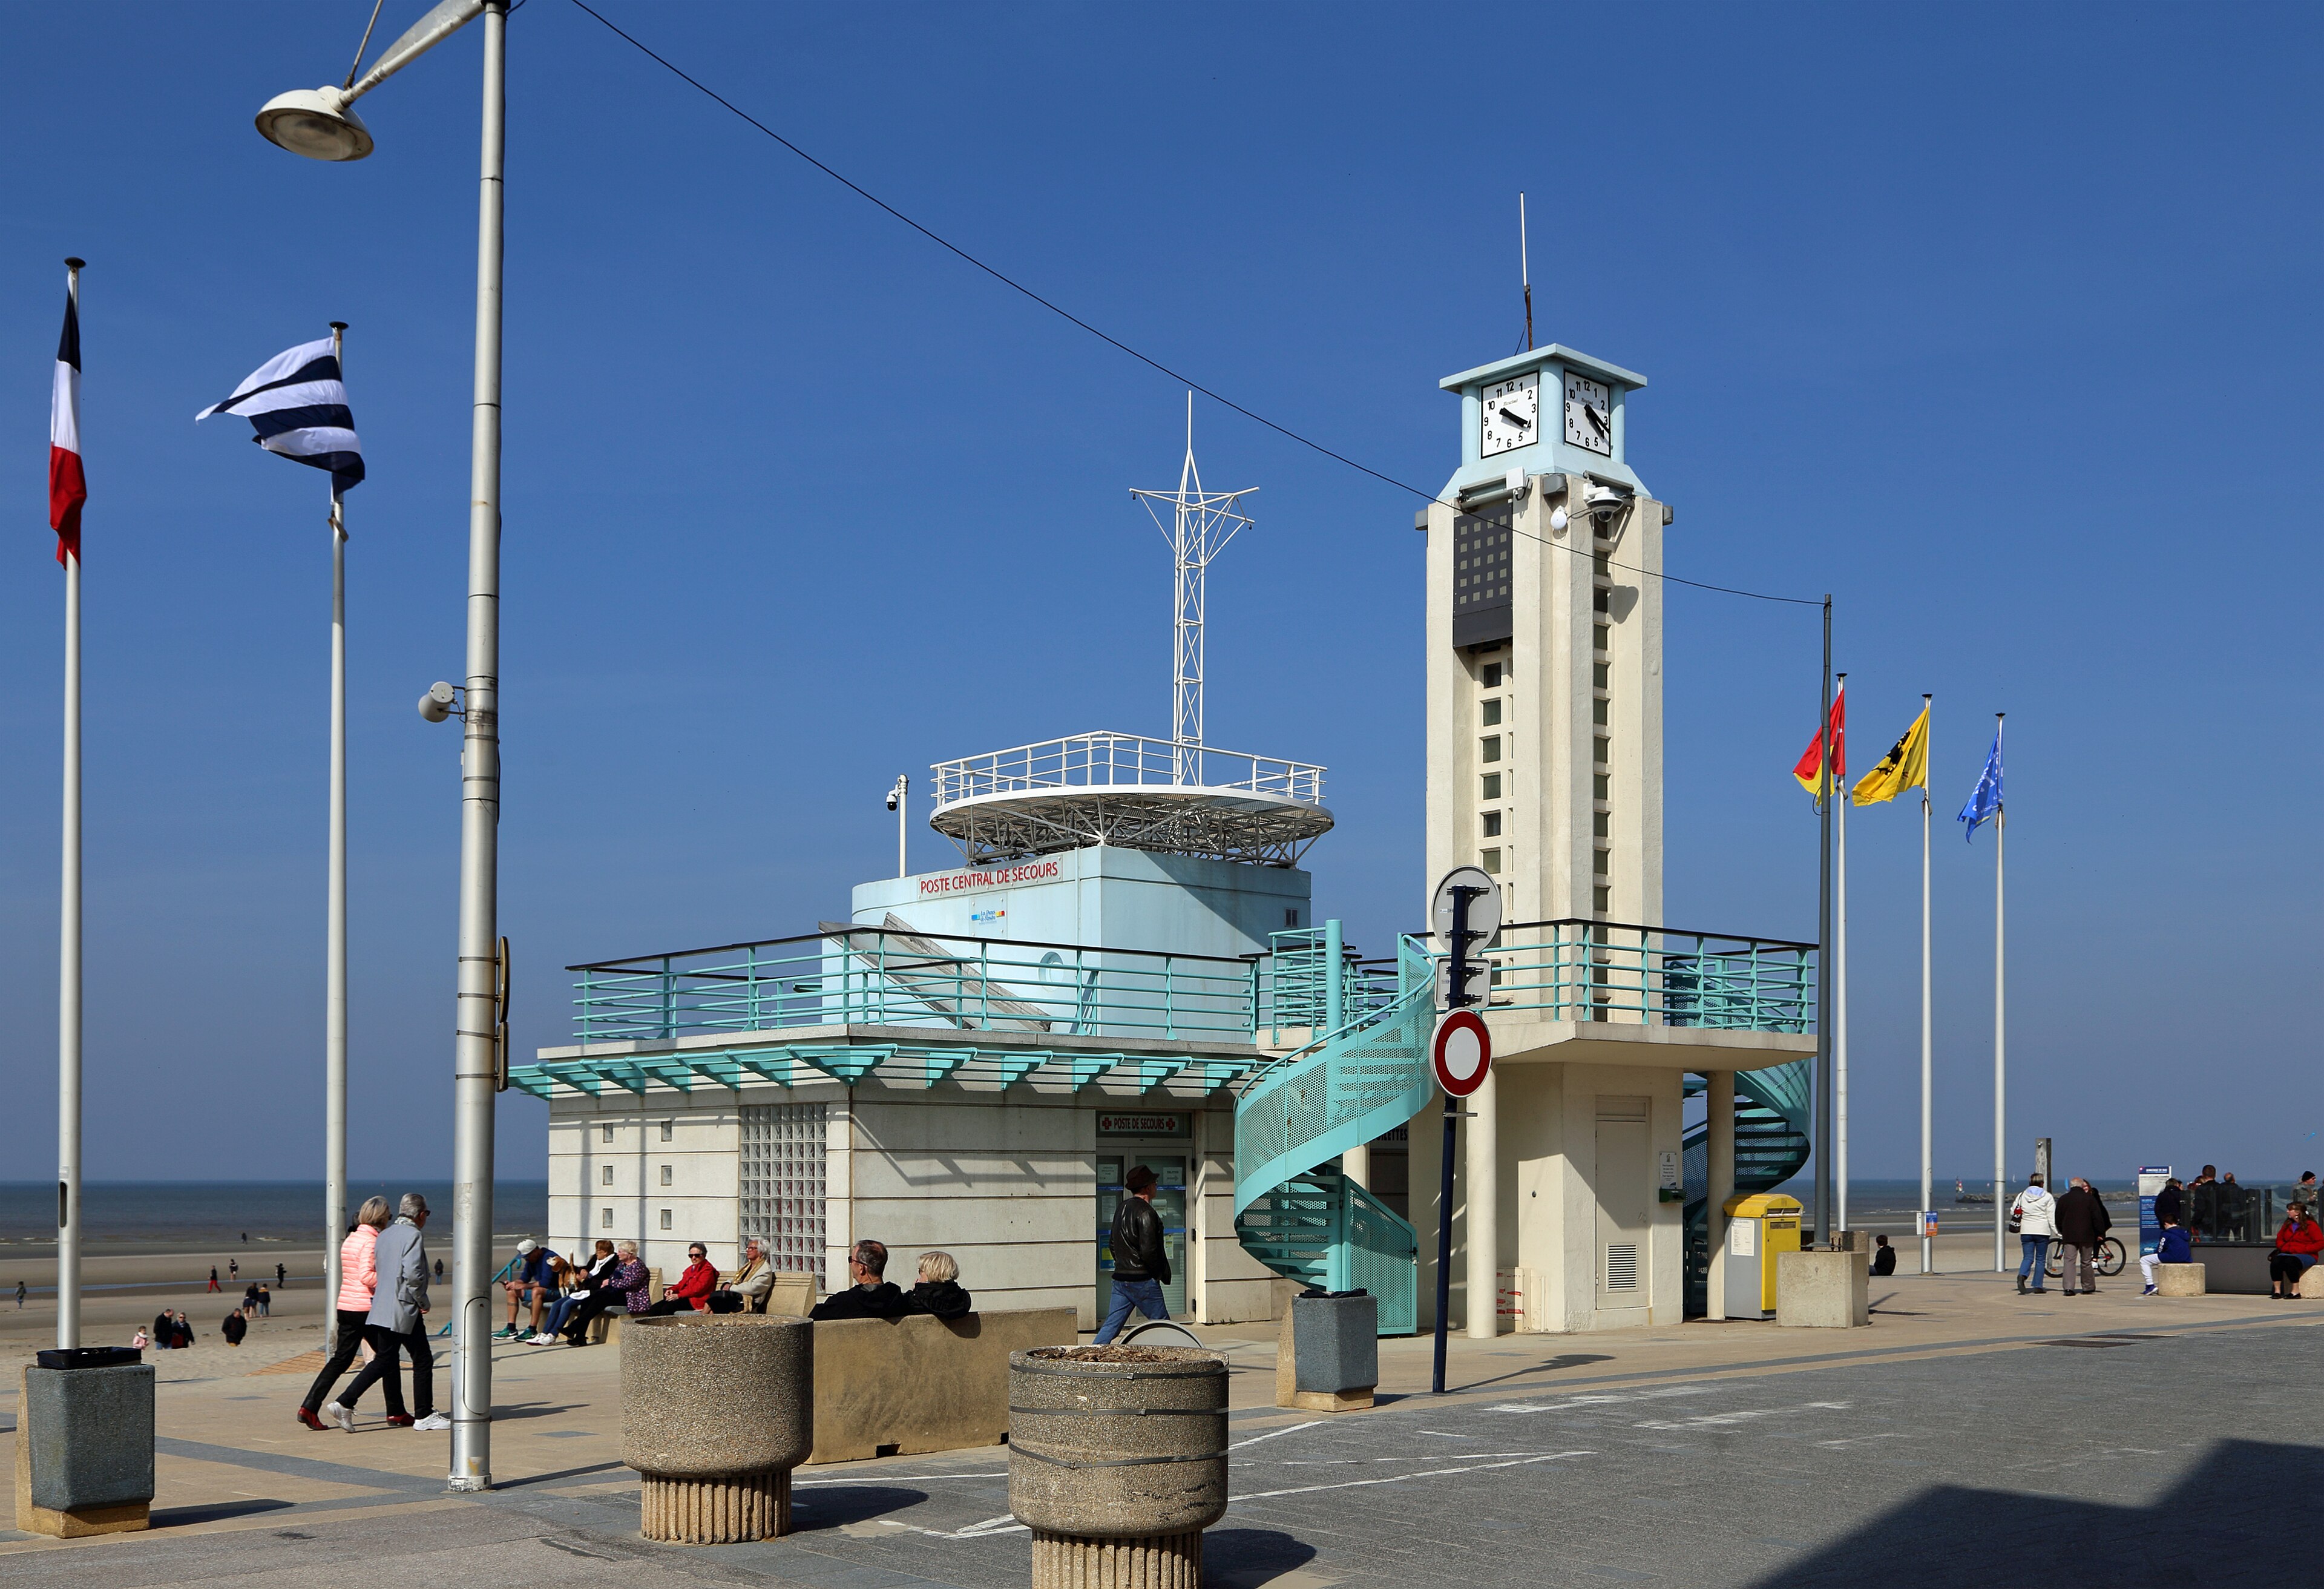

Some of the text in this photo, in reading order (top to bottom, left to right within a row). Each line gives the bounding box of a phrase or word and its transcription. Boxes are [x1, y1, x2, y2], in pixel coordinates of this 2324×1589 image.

[1506, 381, 1514, 392] 12
[1519, 382, 1523, 392] 1
[1575, 381, 1581, 392] 11
[1583, 380, 1590, 392] 12
[1496, 387, 1502, 399] 11
[1528, 389, 1532, 400] 2
[1569, 388, 1575, 400] 10
[1594, 387, 1598, 398] 1
[1488, 400, 1495, 411] 10
[1531, 403, 1536, 413] 3
[1566, 402, 1571, 412] 9
[1601, 400, 1605, 410] 2
[1484, 416, 1489, 426] 9
[1569, 418, 1574, 428] 8
[1604, 416, 1608, 426] 3
[1488, 430, 1492, 440] 8
[1518, 432, 1523, 442] 5
[1576, 430, 1581, 440] 7
[1496, 438, 1501, 448] 7
[1506, 438, 1512, 448] 6
[1585, 437, 1590, 447] 6
[1594, 437, 1598, 447] 5
[921, 861, 1058, 894] POSTE CENTRAL DE SECOURS
[1114, 1117, 1164, 1130] POSTE DE SECOURS
